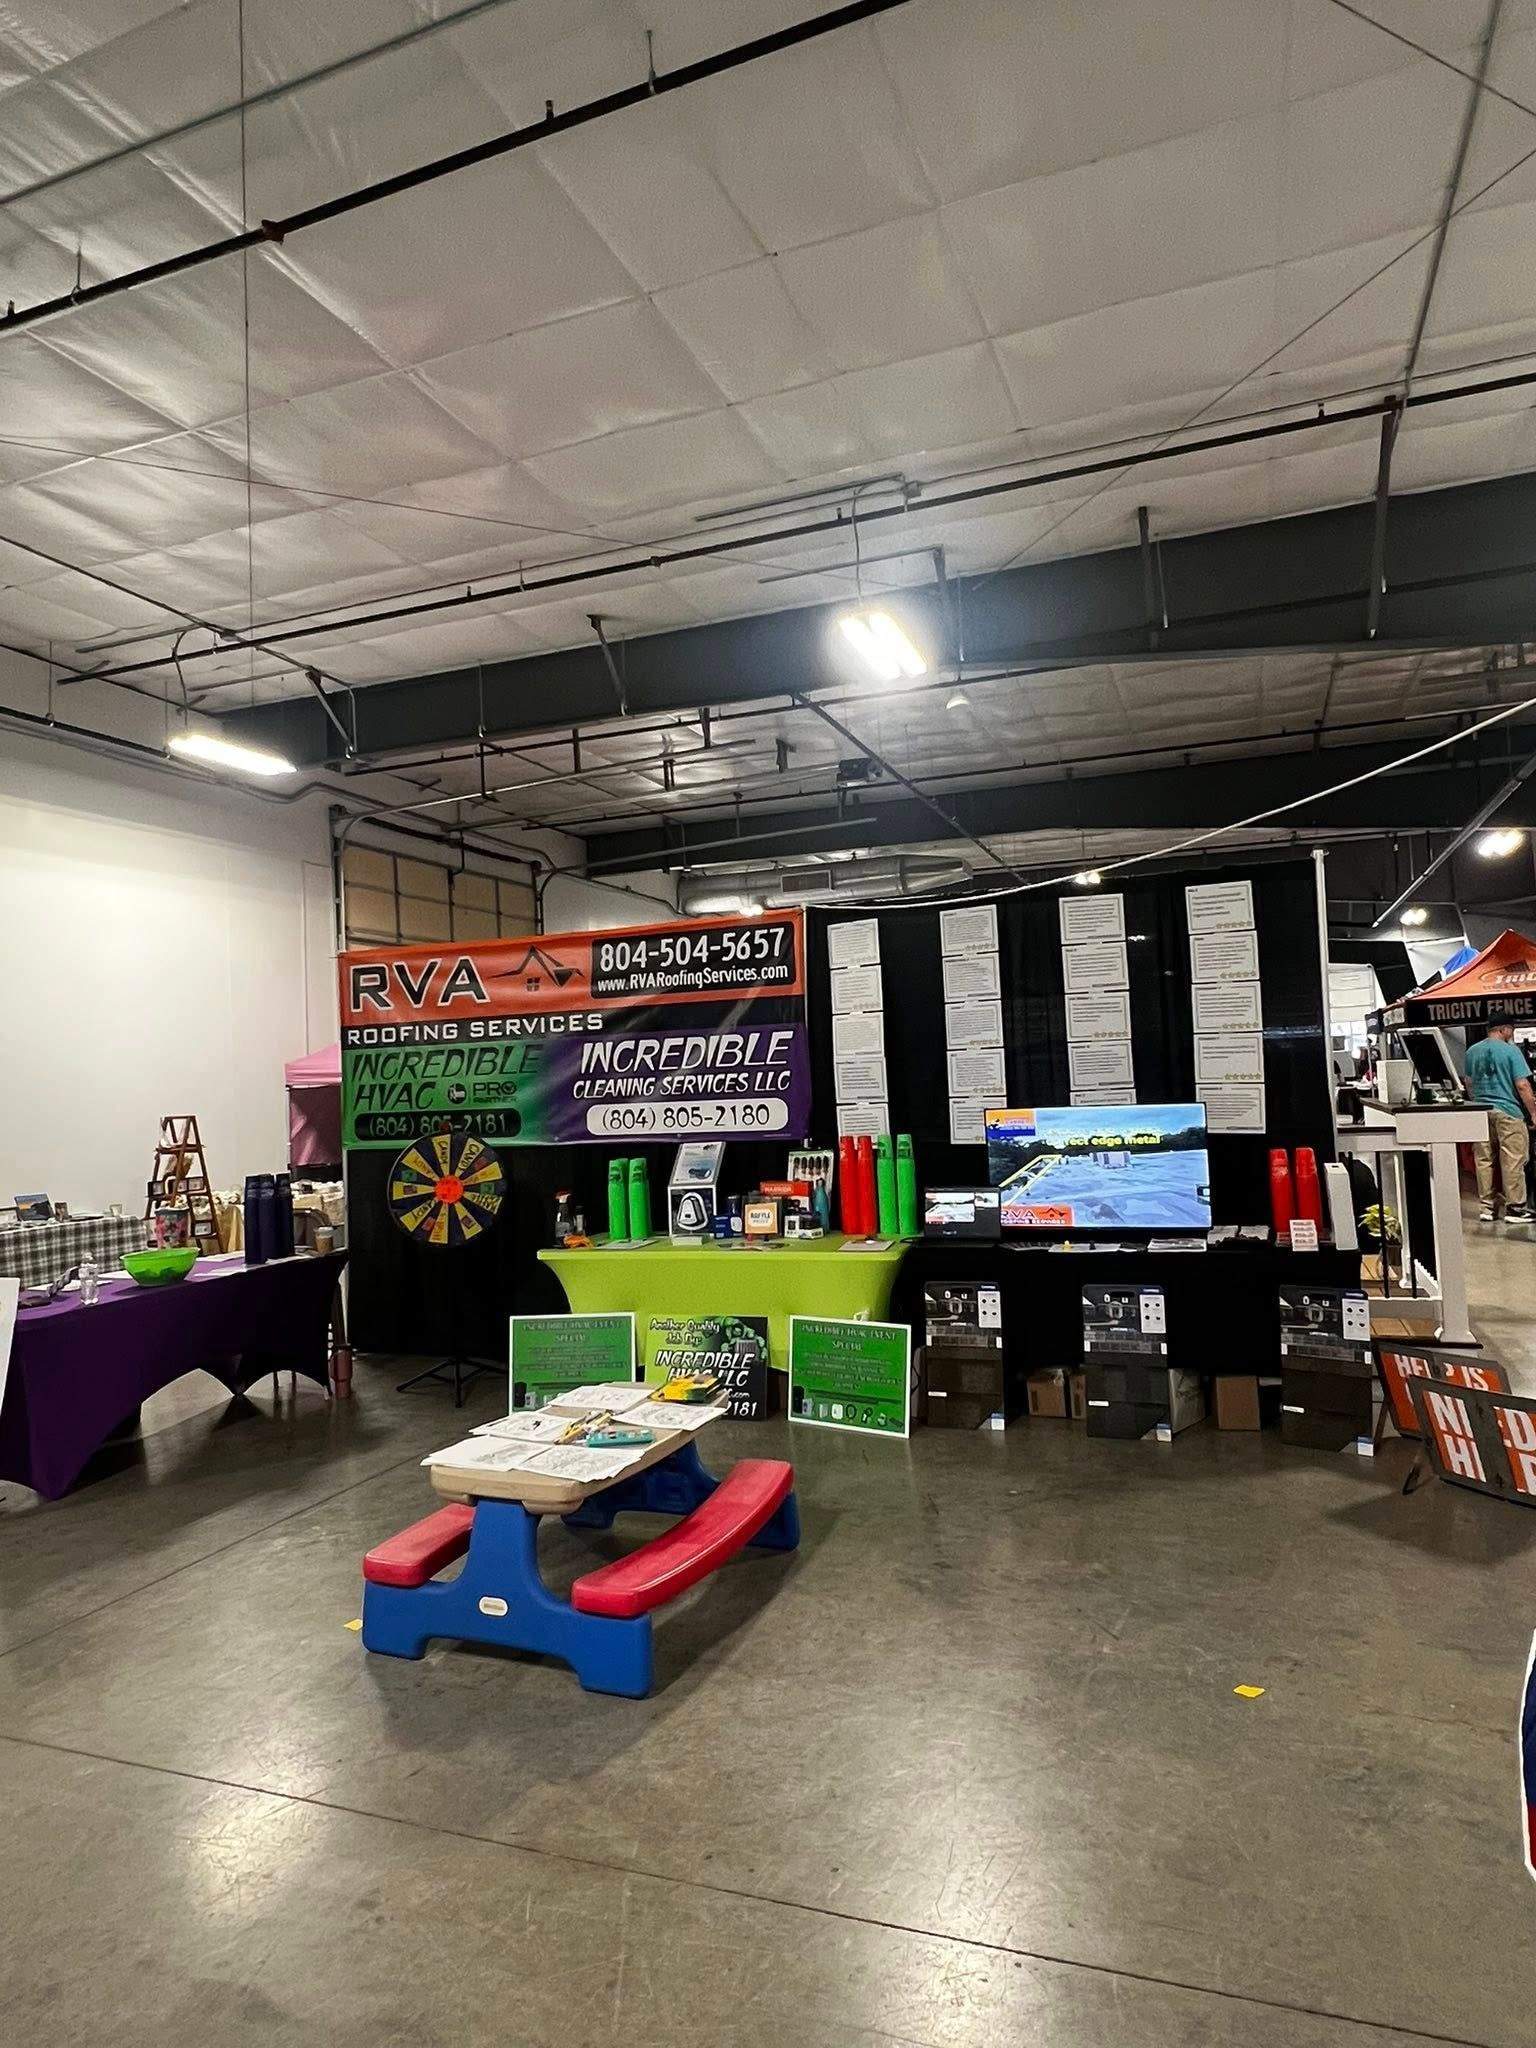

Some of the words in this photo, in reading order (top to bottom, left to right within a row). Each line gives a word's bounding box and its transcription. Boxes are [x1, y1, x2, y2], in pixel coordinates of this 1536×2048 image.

[599, 927, 785, 972] 804-504-5657
[350, 955, 491, 1013] RVA
[597, 963, 789, 992] www.RVARoofingServices.com
[1427, 1001, 1481, 1021] TRICITY
[1487, 998, 1533, 1016] FENCE
[347, 1023, 459, 1046] ROOFING
[469, 1013, 603, 1038] SERVICES
[351, 1043, 545, 1082] INCREDIBLE
[581, 1030, 794, 1075] INCREDIBLE
[353, 1081, 436, 1112] HVAC
[572, 1076, 656, 1100] CLEANING
[659, 1072, 749, 1096] SERVICES
[754, 1070, 791, 1092] LLC
[369, 1115, 415, 1138] (804)
[602, 1106, 657, 1132] (804)
[663, 1103, 770, 1129] 805-2180
[1091, 1136, 1122, 1147] edge
[1124, 1135, 1160, 1145] metal
[650, 1318, 685, 1331] Another
[687, 1319, 720, 1334] Quality
[666, 1332, 682, 1344] Job
[655, 1350, 755, 1370] INCREDIBLE
